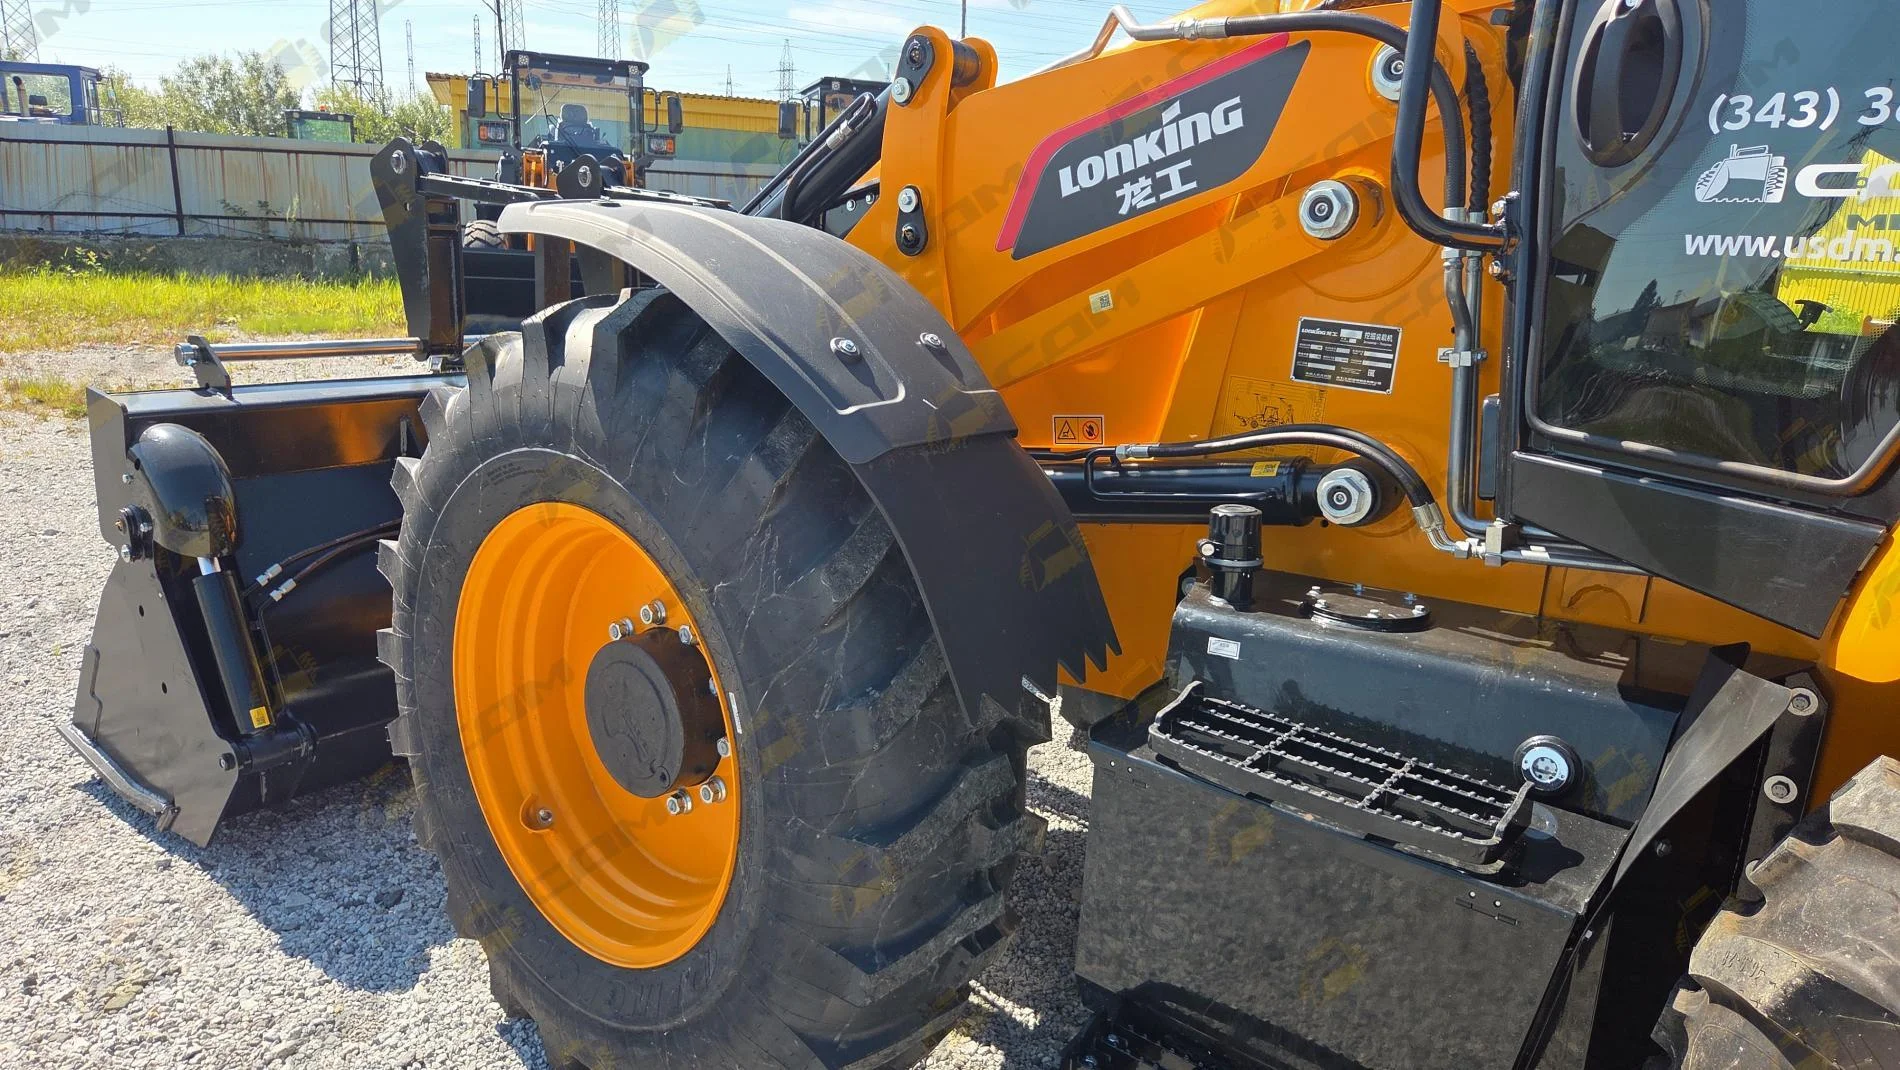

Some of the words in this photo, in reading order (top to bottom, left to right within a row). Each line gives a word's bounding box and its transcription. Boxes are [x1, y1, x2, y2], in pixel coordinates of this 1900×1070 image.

[1708, 86, 1840, 135] (343)
[1857, 86, 1900, 125] 3
[1115, 158, 1198, 216] 龙工
